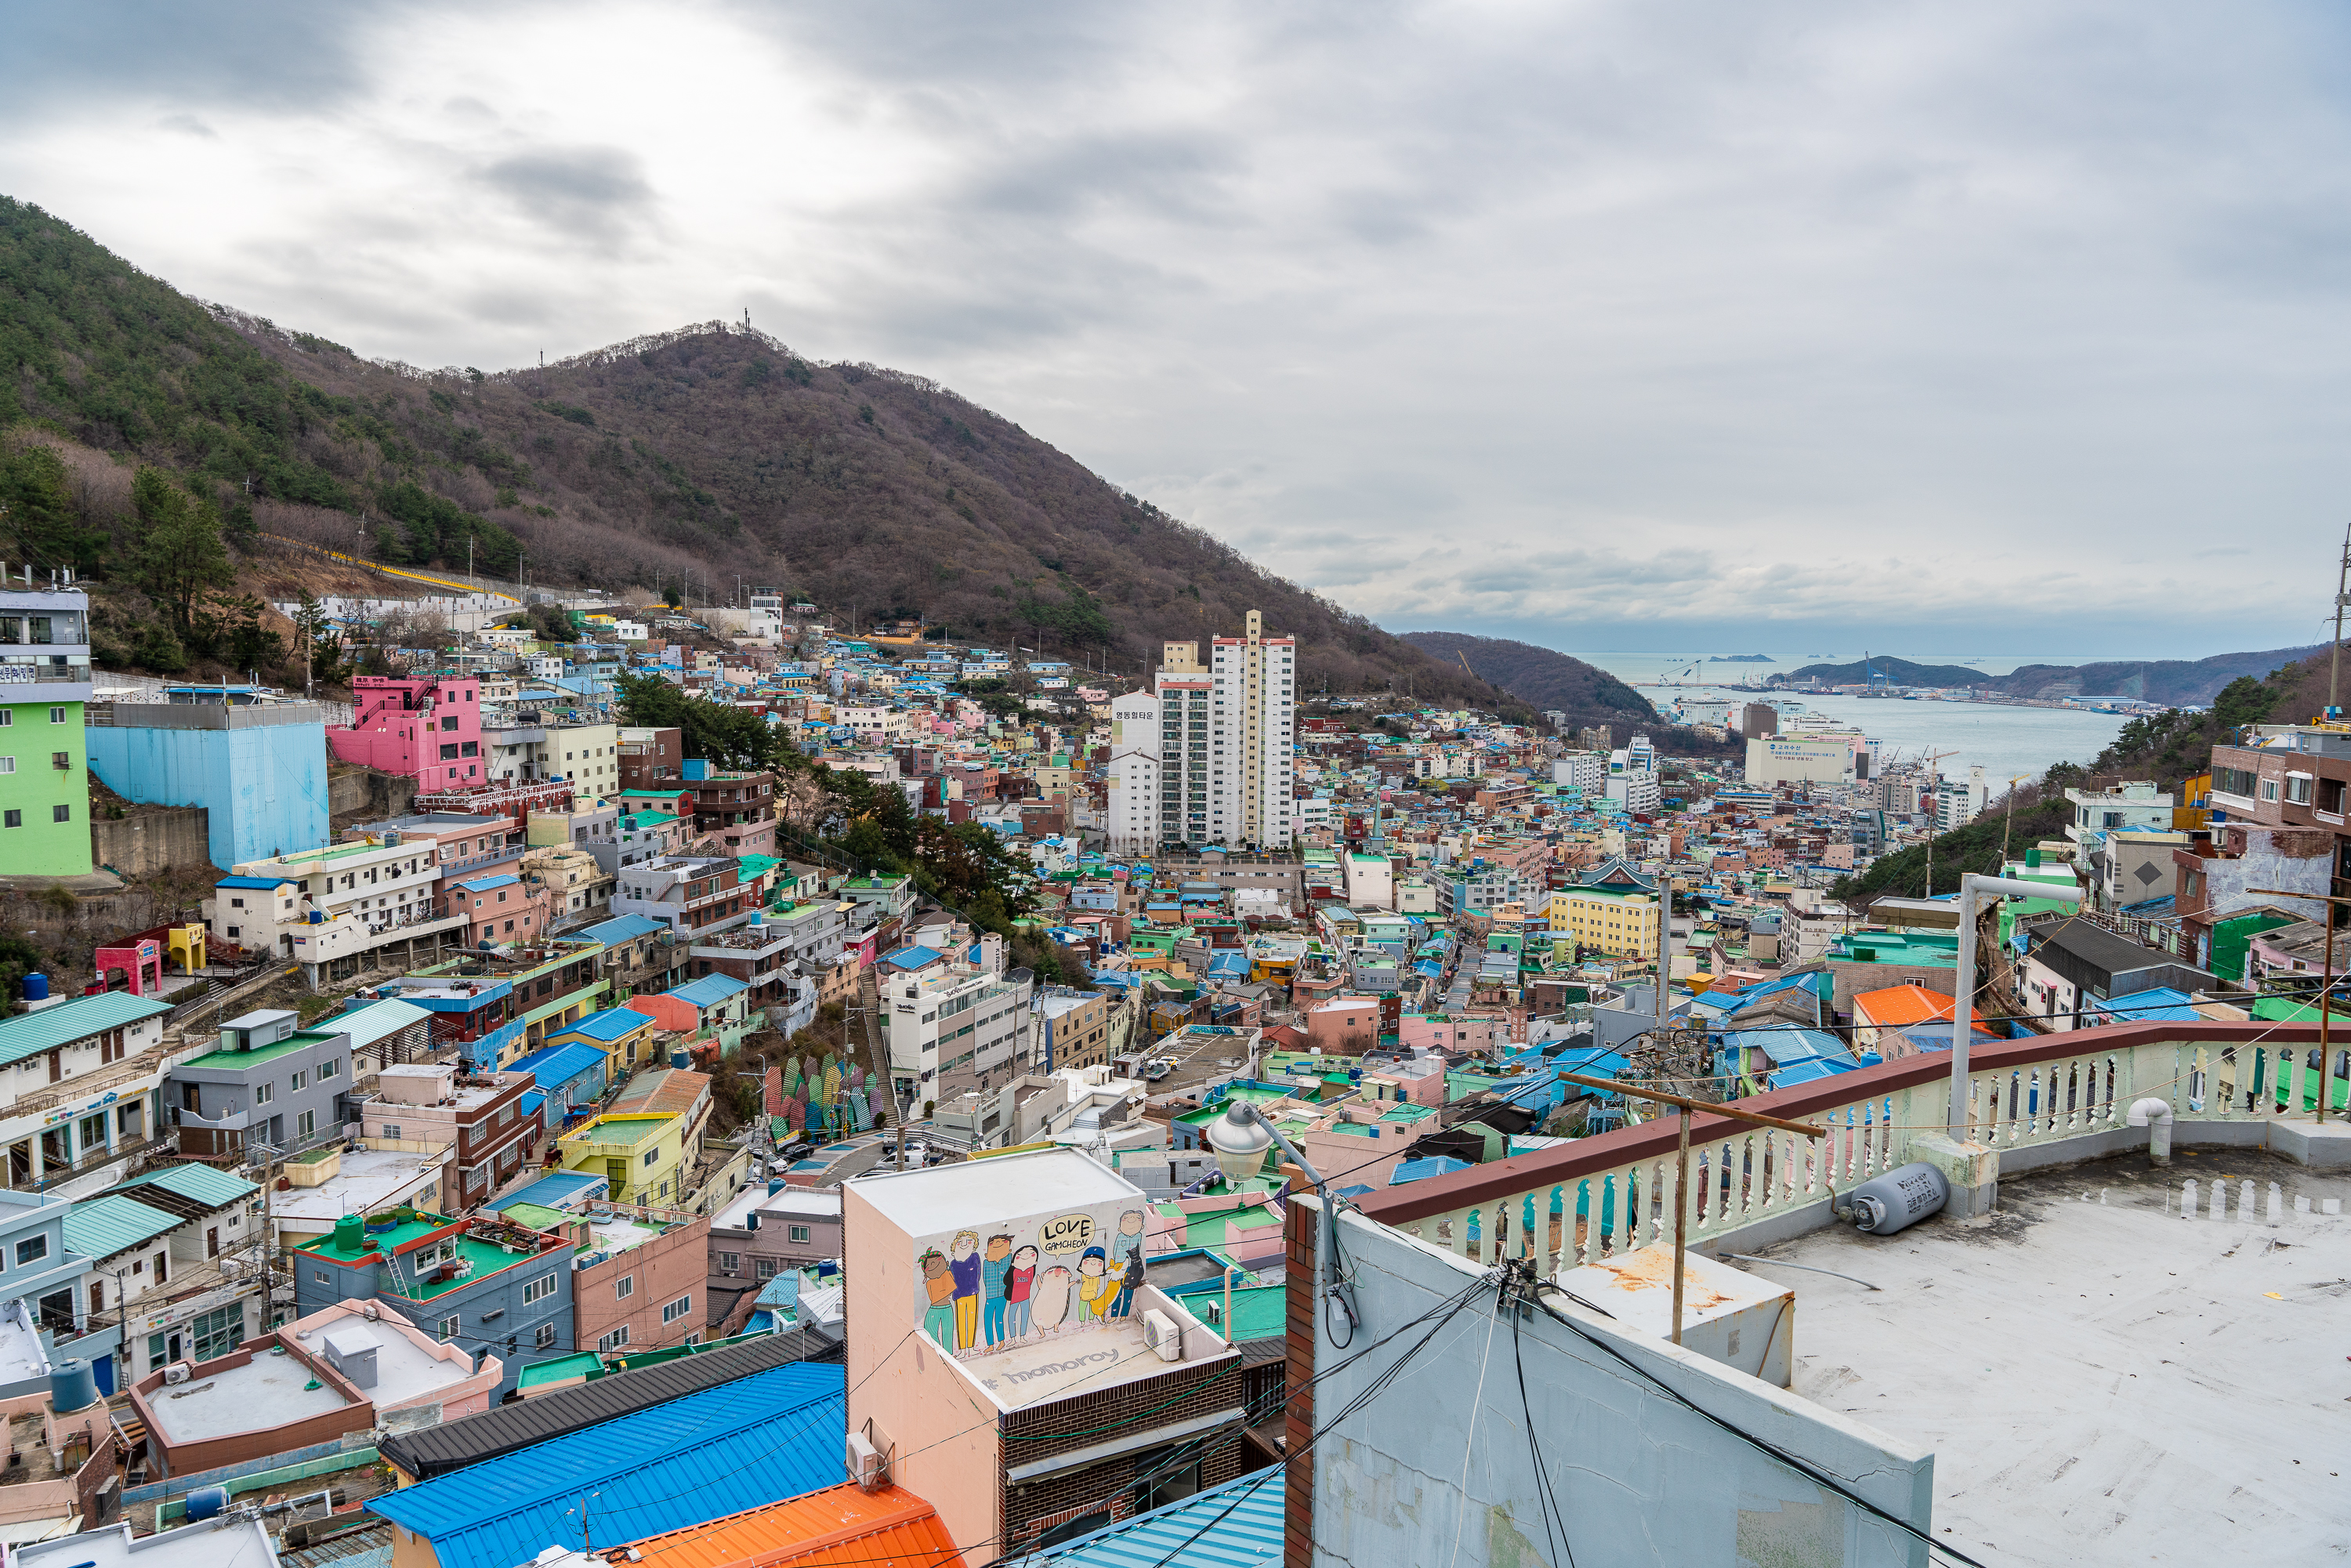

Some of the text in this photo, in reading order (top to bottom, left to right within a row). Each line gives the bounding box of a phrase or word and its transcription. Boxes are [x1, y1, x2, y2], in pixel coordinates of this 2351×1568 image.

[1045, 1219, 1090, 1240] LOVE
[1045, 1239, 1088, 1251] GAMCHEON
[1002, 1349, 1119, 1385] momoroy
